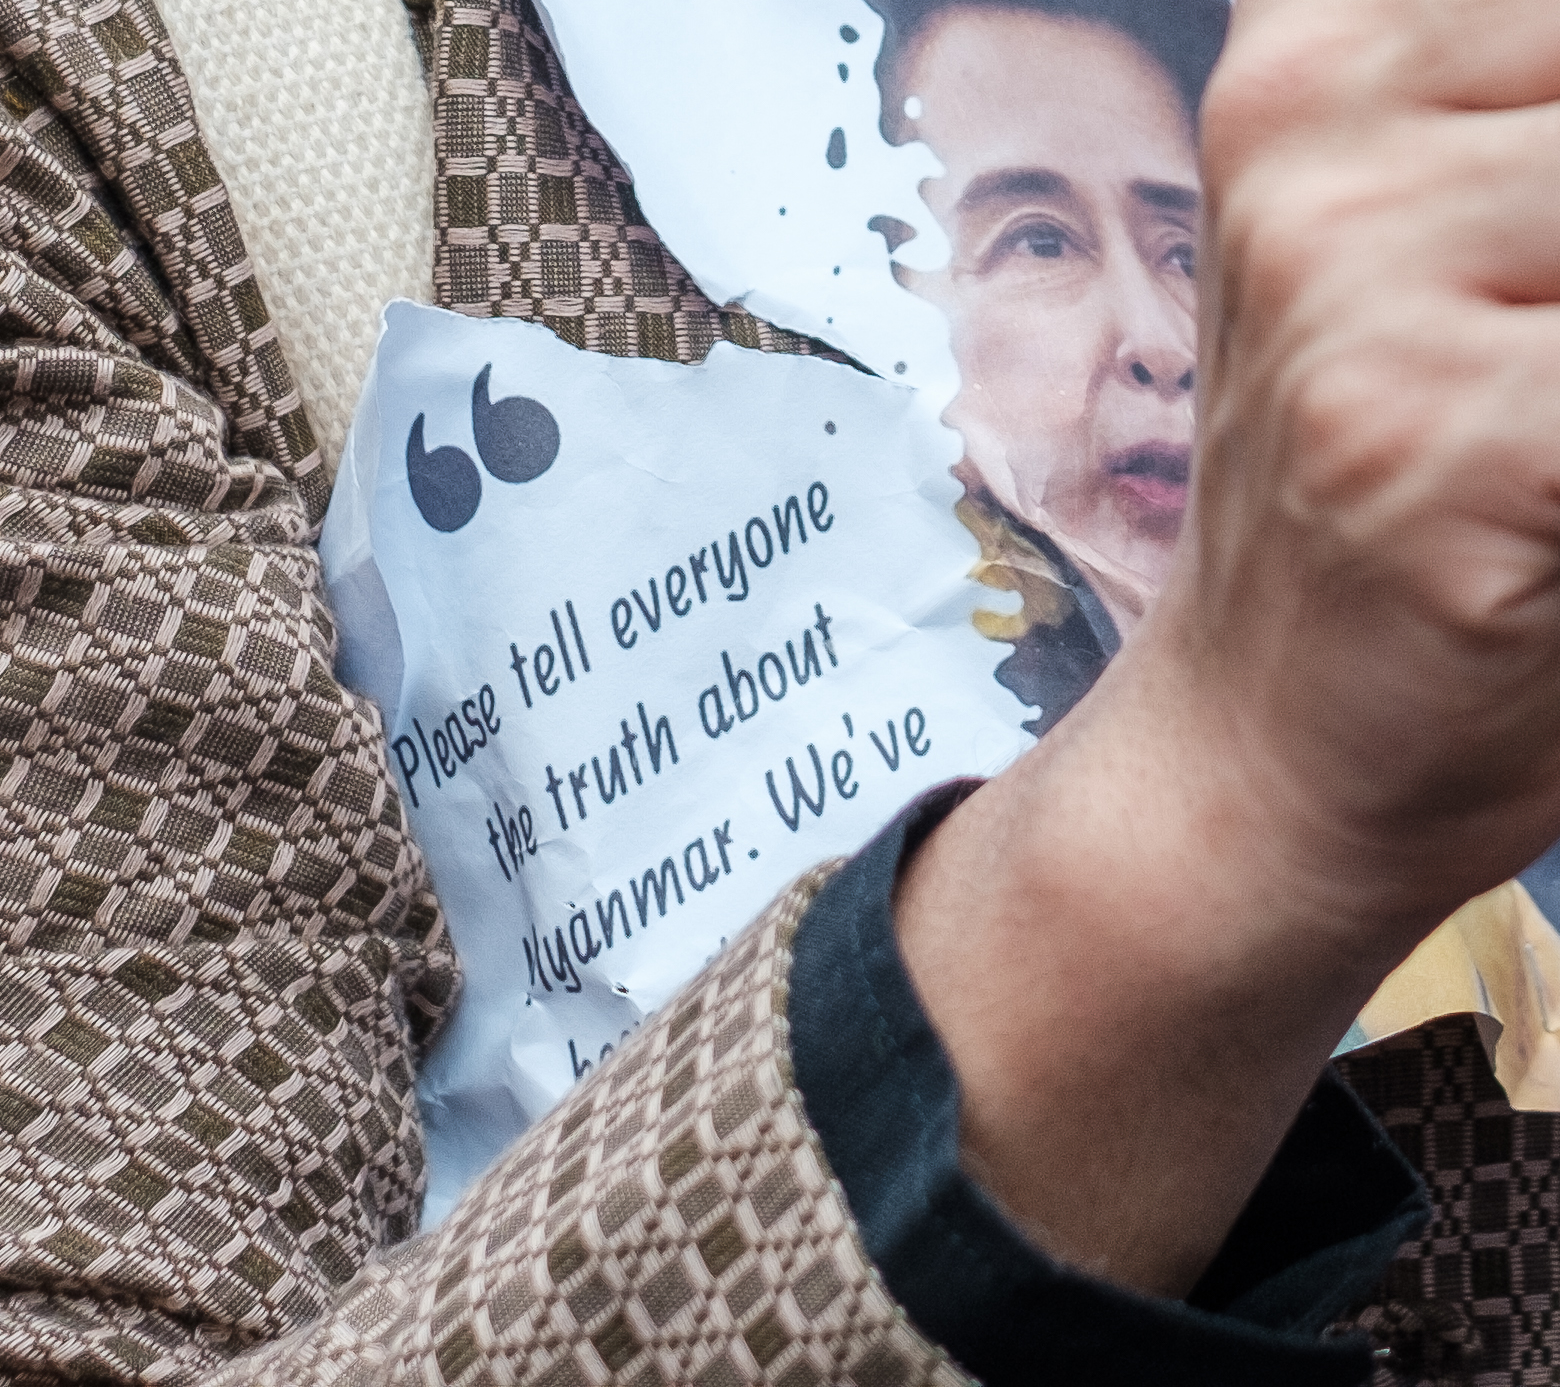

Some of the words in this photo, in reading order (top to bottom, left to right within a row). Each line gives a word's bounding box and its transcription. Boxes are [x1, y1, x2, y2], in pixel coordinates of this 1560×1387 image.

[391, 683, 502, 809] Please
[508, 600, 592, 710] tell
[609, 479, 836, 654] everyone
[486, 801, 538, 883] the
[544, 702, 680, 832] truth
[697, 602, 840, 741] about
[765, 706, 933, 834] We've
